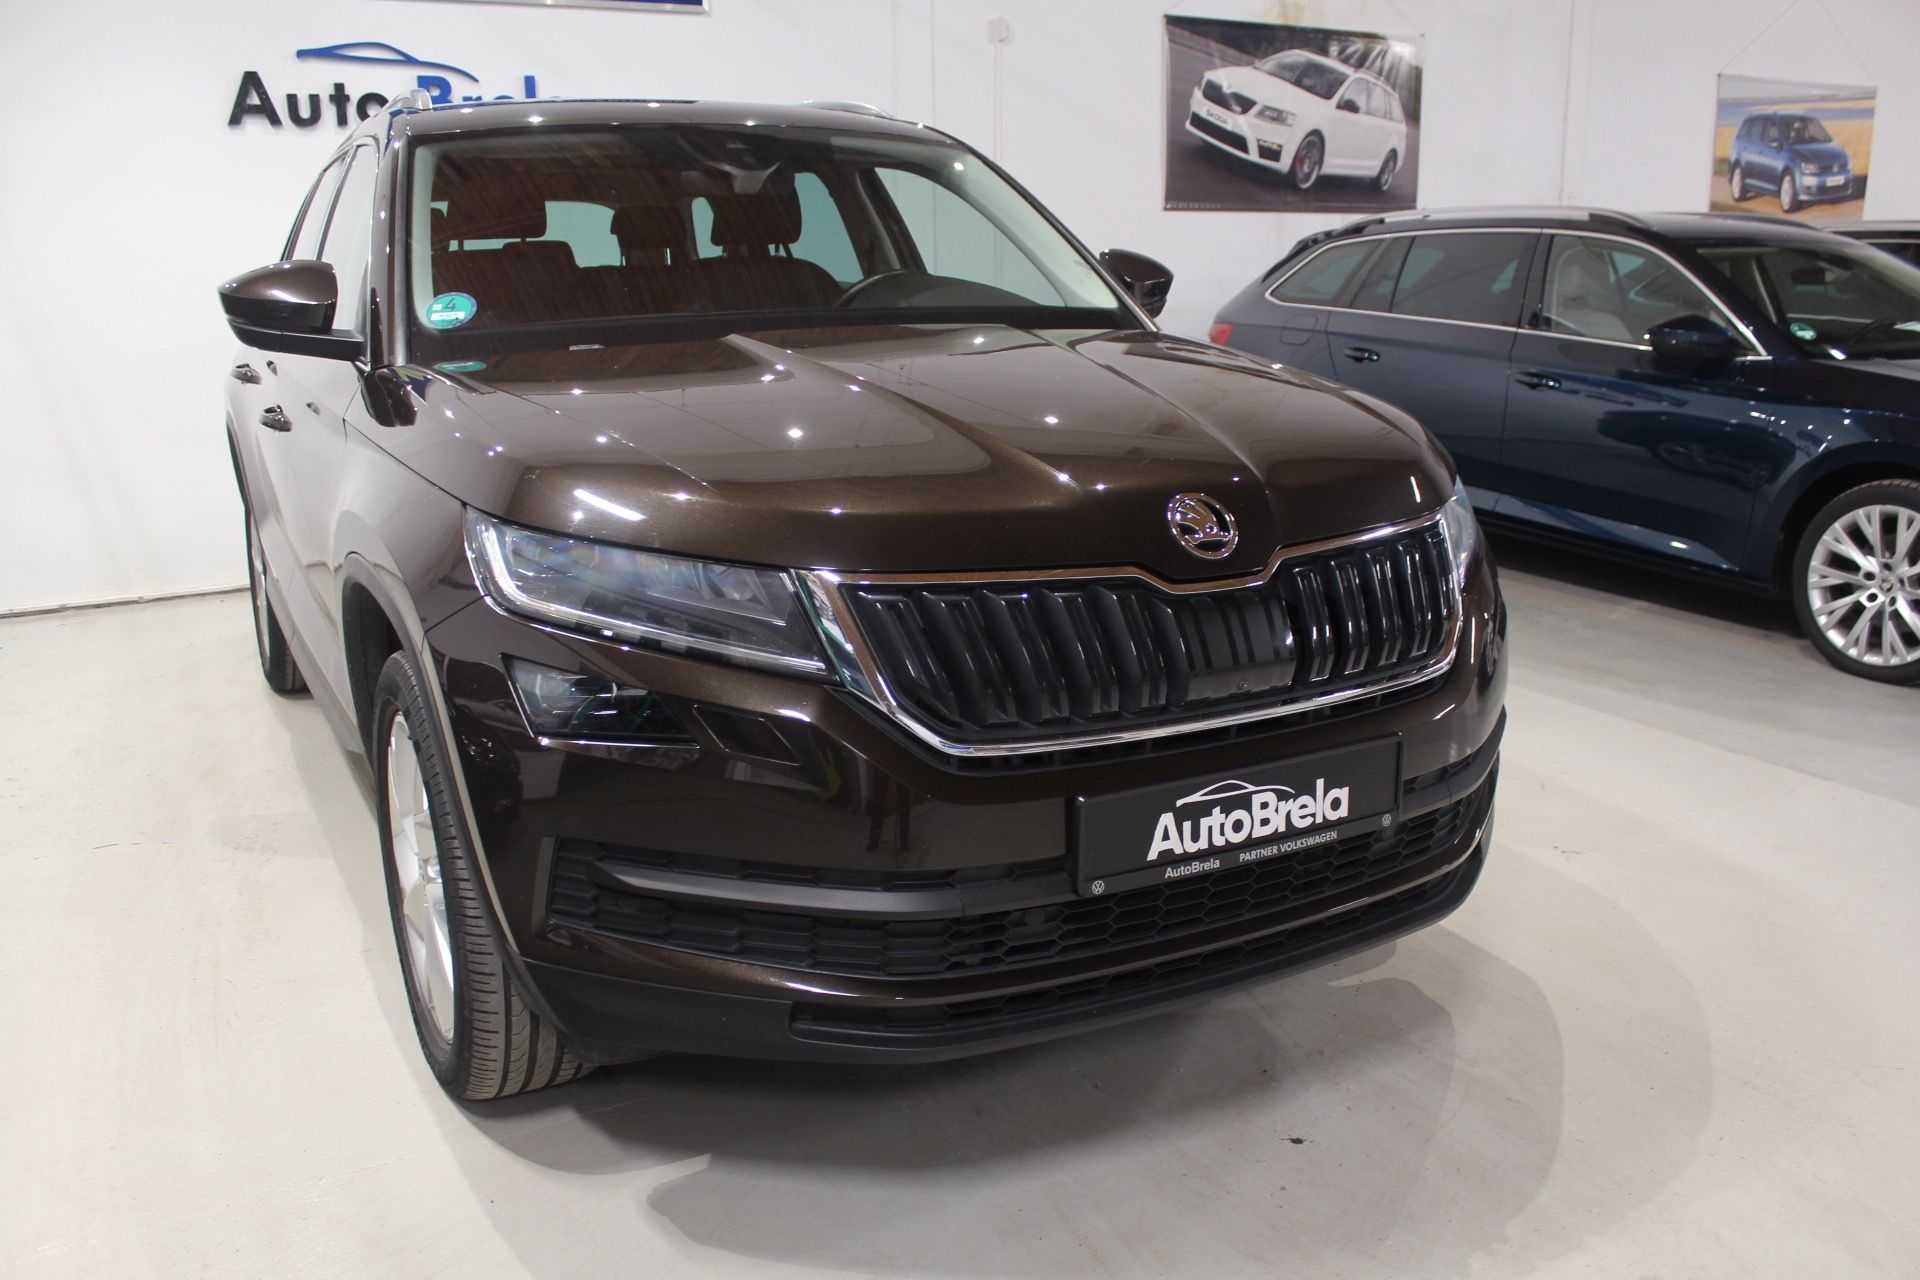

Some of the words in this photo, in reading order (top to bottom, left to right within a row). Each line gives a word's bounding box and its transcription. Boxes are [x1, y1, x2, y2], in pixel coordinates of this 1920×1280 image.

[444, 297, 456, 310] 4
[1147, 779, 1349, 861] AutoBrela
[1165, 858, 1220, 879] AutoBrela
[1239, 845, 1278, 863] PARTNER
[1280, 830, 1338, 853] VOLKSWAGEN
